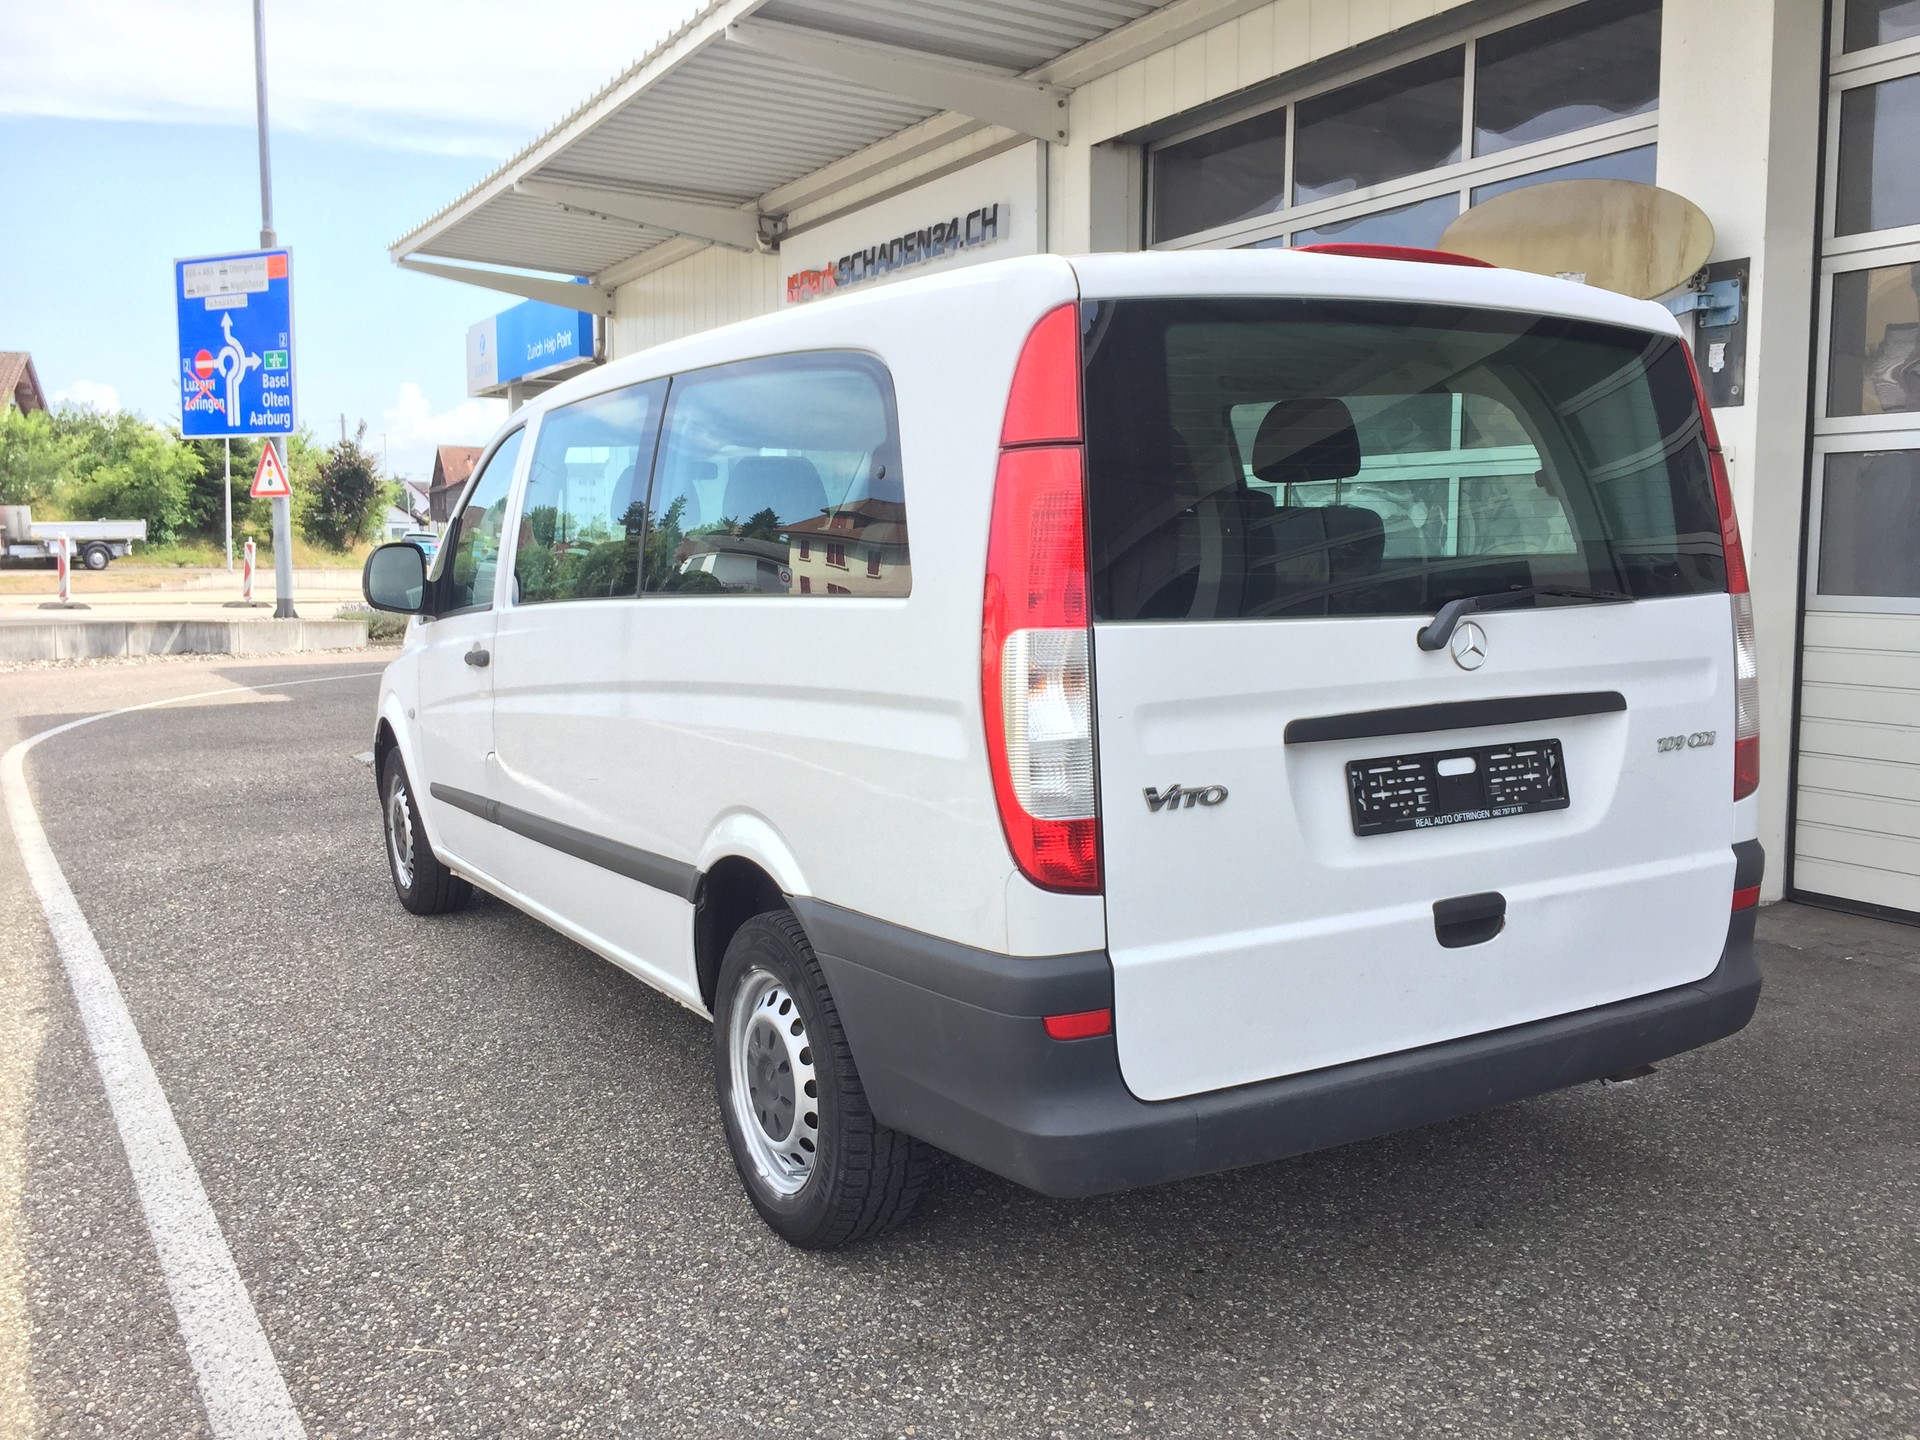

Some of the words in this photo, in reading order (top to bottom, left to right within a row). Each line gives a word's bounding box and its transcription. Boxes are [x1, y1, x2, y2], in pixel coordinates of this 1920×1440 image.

[527, 340, 543, 361] Zurich
[543, 336, 556, 355] Help
[557, 330, 572, 350] Point
[262, 371, 289, 388] Basel
[262, 391, 290, 408] Olten
[250, 409, 291, 429] Aarburg
[1657, 735, 1686, 753] 109
[1687, 731, 1717, 748] CDI
[1415, 818, 1434, 828] REAL
[1434, 815, 1453, 826] AUTO
[1453, 809, 1491, 823] OFTRINGEN
[1492, 808, 1502, 817] 062
